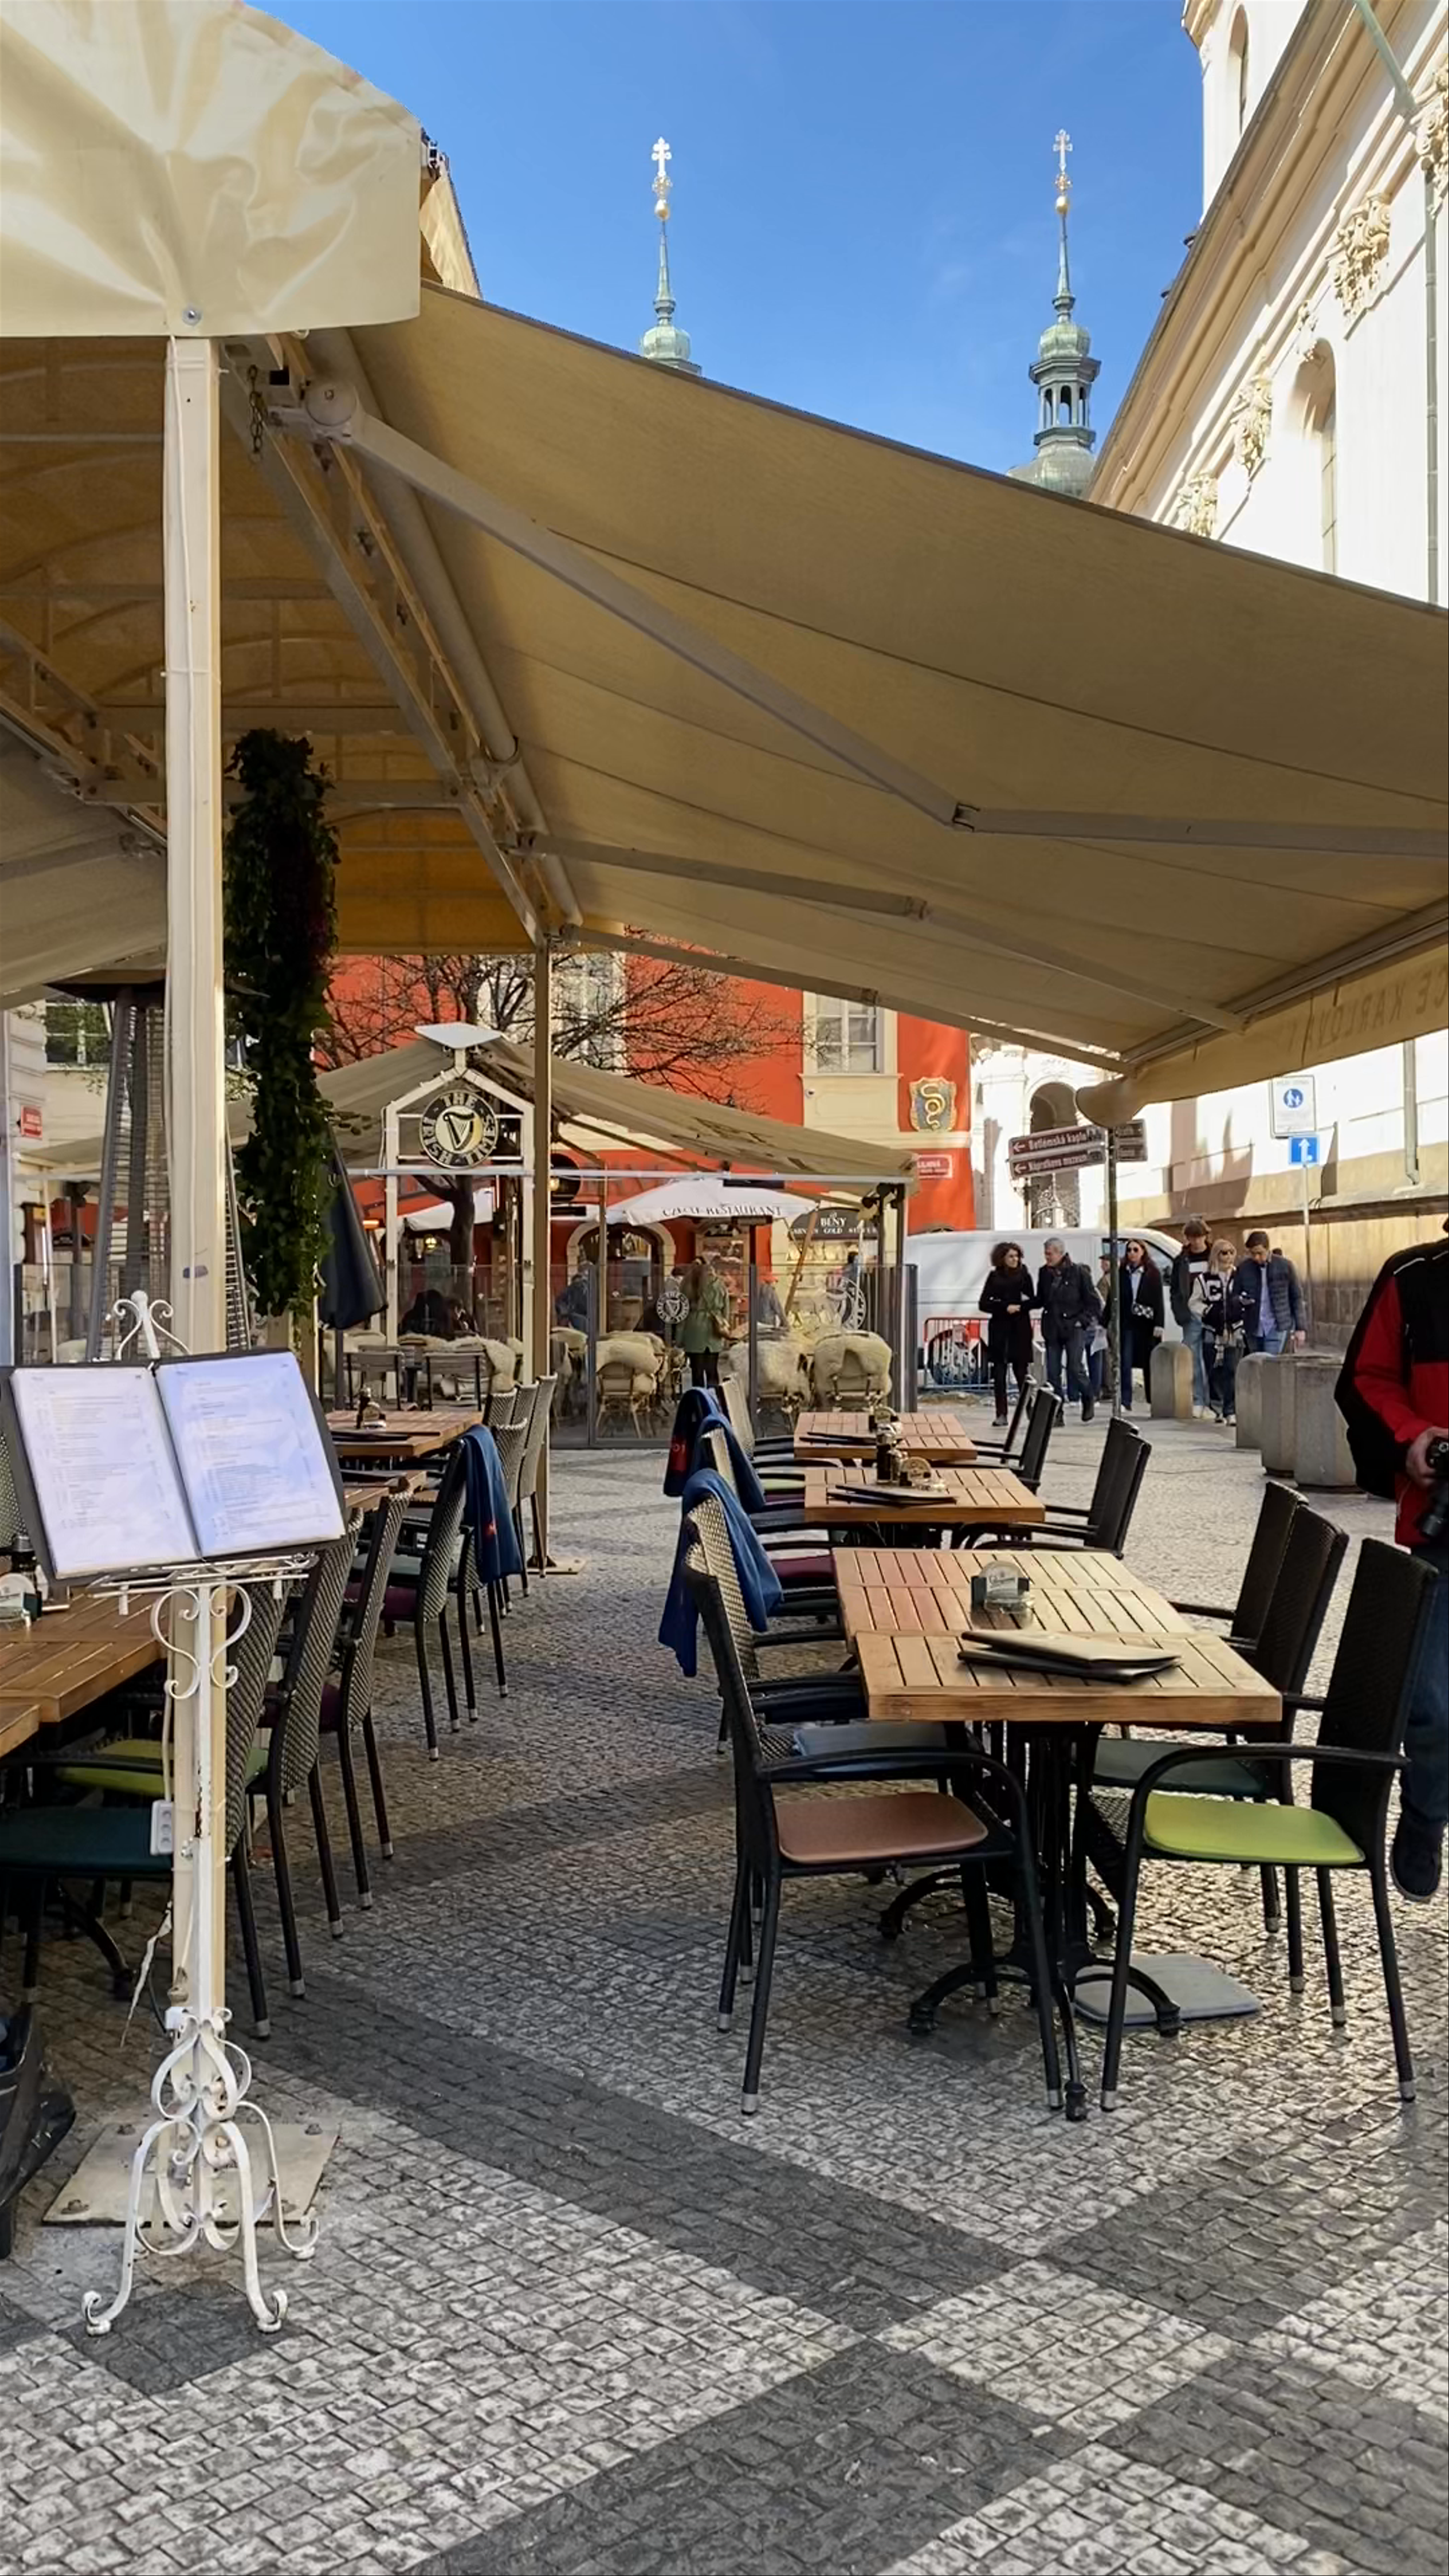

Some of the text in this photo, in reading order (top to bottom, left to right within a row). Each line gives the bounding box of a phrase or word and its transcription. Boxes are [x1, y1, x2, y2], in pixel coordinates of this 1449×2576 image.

[439, 1092, 478, 1108] THE
[423, 1117, 453, 1165] IRISH
[463, 1114, 495, 1165] TIMES
